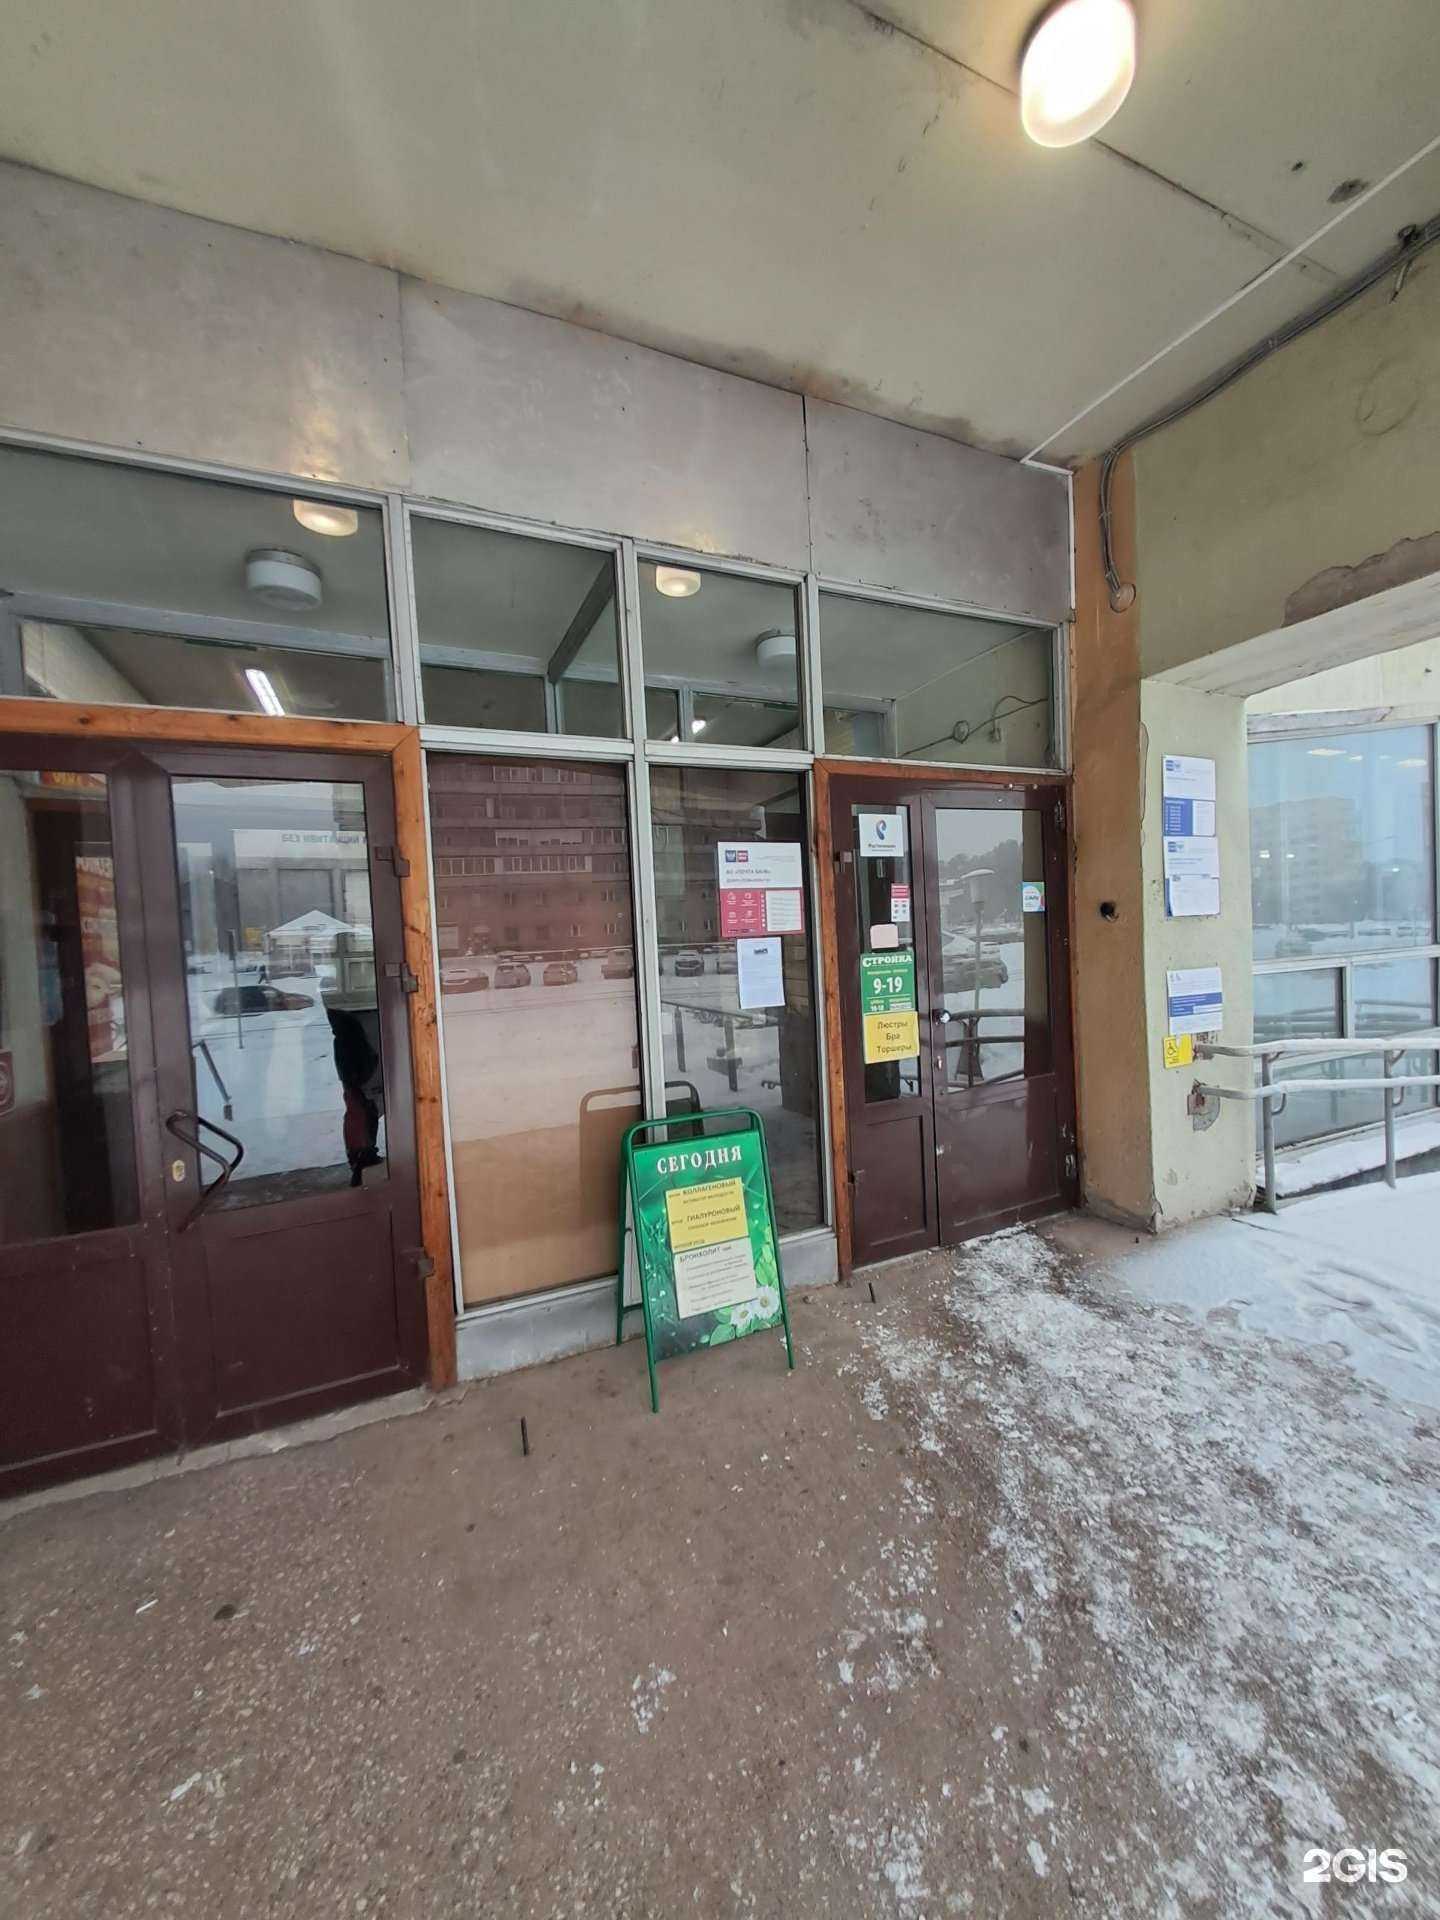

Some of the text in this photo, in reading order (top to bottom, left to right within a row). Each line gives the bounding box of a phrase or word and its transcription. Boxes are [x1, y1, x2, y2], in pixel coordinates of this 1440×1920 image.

[873, 976, 903, 995] 9-19
[877, 1020, 909, 1031] Люстры
[886, 1032, 901, 1041] Бра
[876, 1044, 913, 1055] Торшеры
[657, 1145, 742, 1174] СЕГОДНЯ
